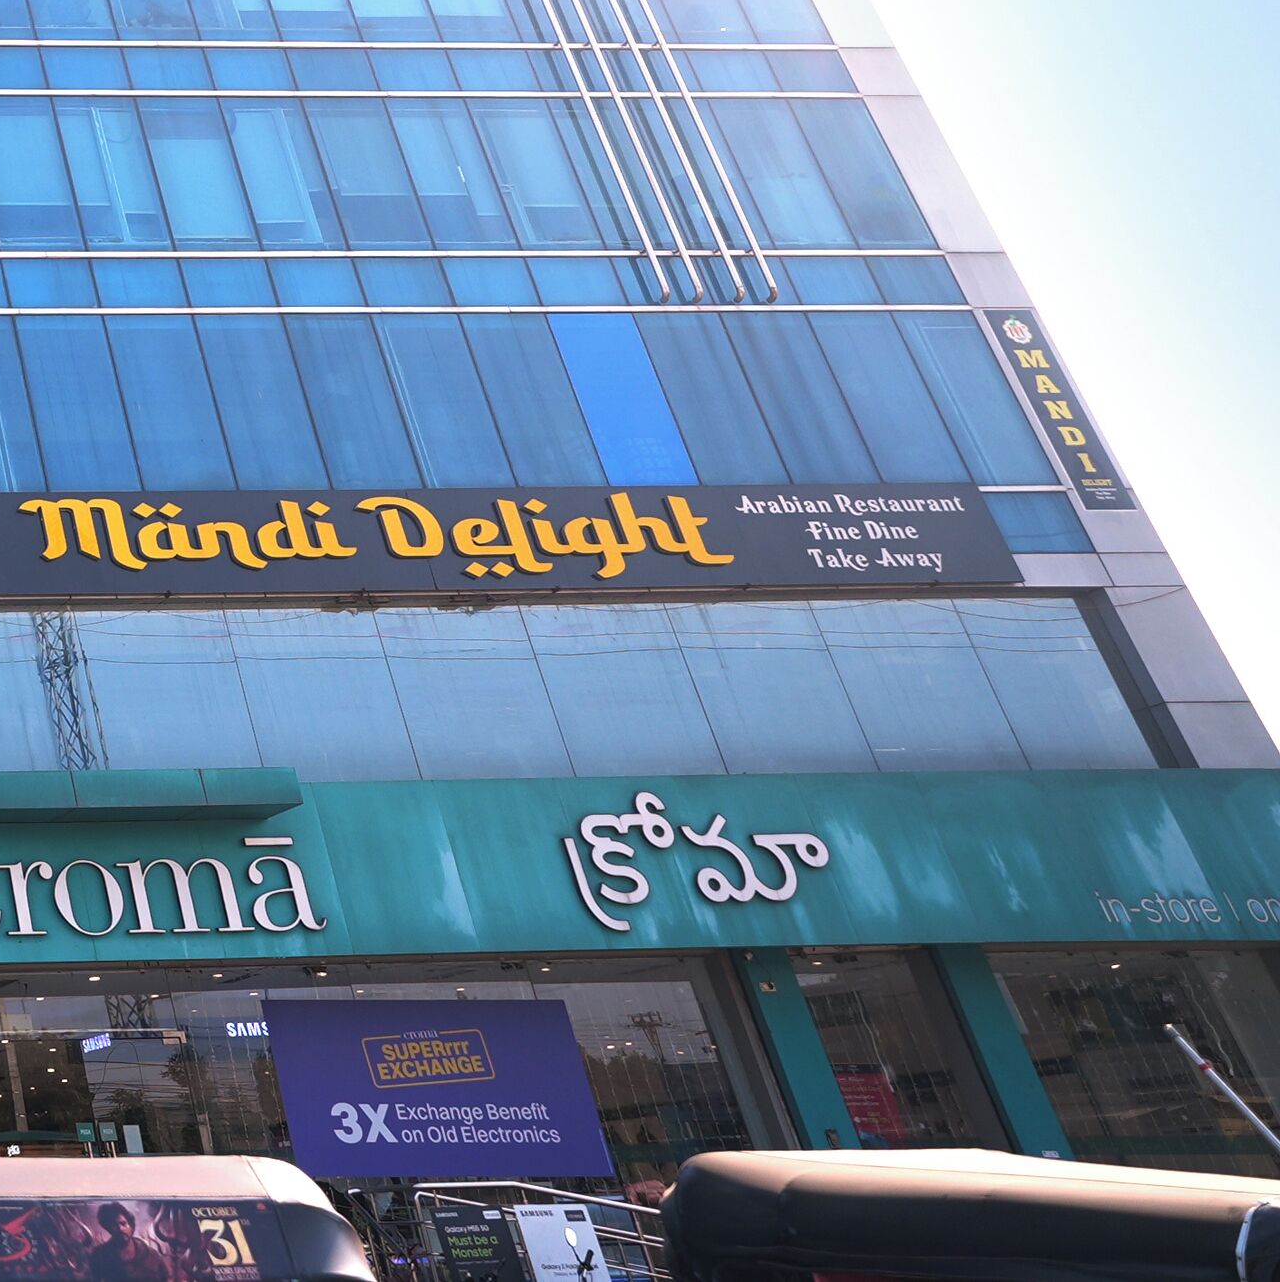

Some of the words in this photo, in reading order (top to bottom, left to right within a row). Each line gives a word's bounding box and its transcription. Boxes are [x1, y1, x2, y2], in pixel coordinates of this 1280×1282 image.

[1013, 349, 1097, 472] MANDI
[736, 494, 833, 515] Arabian
[833, 493, 966, 516] Restaurant
[354, 491, 736, 580] Delight
[806, 520, 862, 541] Fine
[864, 520, 919, 540] Dine
[807, 548, 869, 571] Take
[875, 548, 943, 572] Away
[1094, 890, 1222, 924] in-store
[376, 1055, 485, 1080] EXCHANGE
[330, 1102, 399, 1144] 3X
[394, 1103, 483, 1125] Exchange
[487, 1102, 550, 1121] Benefit
[401, 1129, 424, 1143] on
[427, 1126, 459, 1143] Old
[461, 1126, 561, 1144] Electronics
[447, 1235, 472, 1246] Must
[473, 1234, 488, 1245] be
[490, 1236, 499, 1245] a
[451, 1249, 493, 1259] Monster
